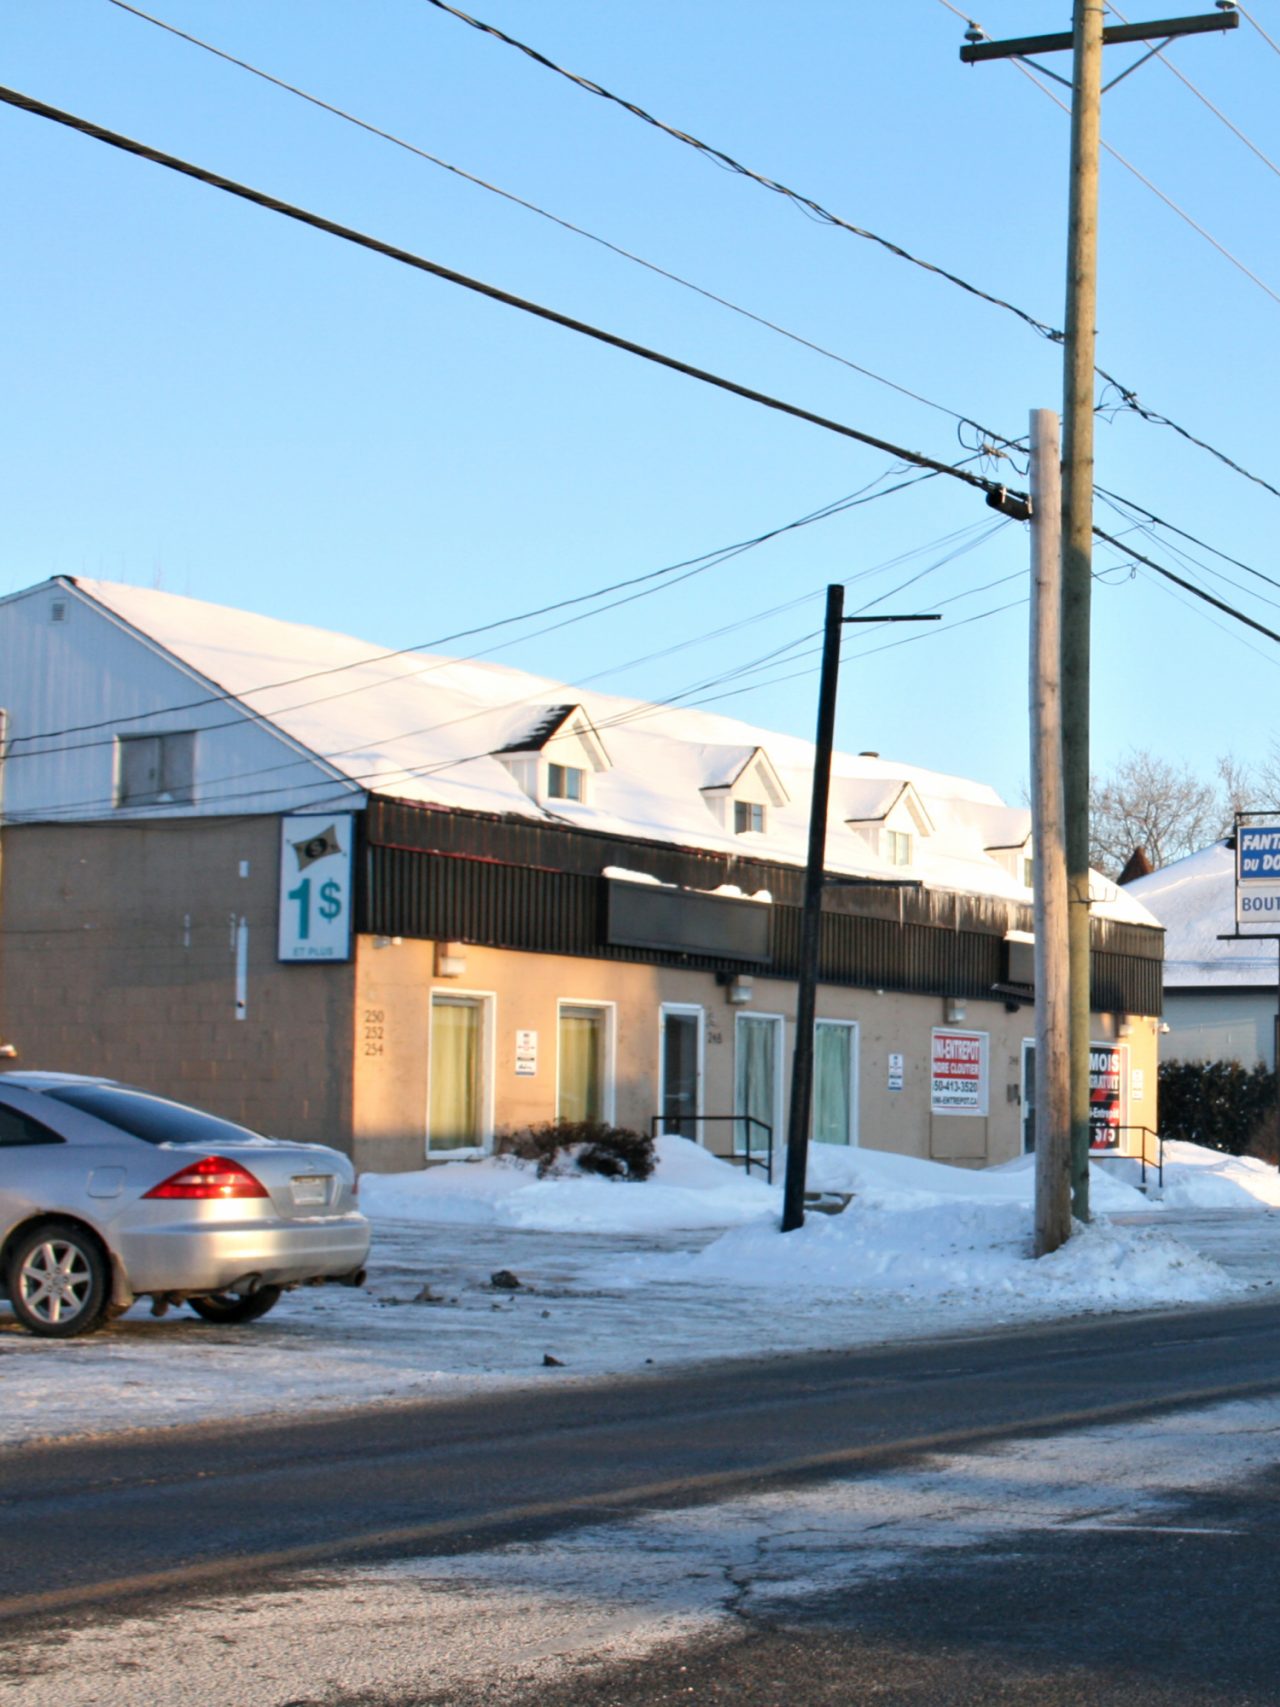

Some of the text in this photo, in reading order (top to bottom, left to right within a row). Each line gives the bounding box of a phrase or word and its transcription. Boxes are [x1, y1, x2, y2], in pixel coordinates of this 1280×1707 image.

[1243, 858, 1259, 871] DU
[293, 946, 333, 957] ET PLUS
[365, 1010, 385, 1023] 250
[365, 1026, 384, 1039] 252
[365, 1043, 384, 1056] 254
[1089, 1054, 1119, 1072] MOIS
